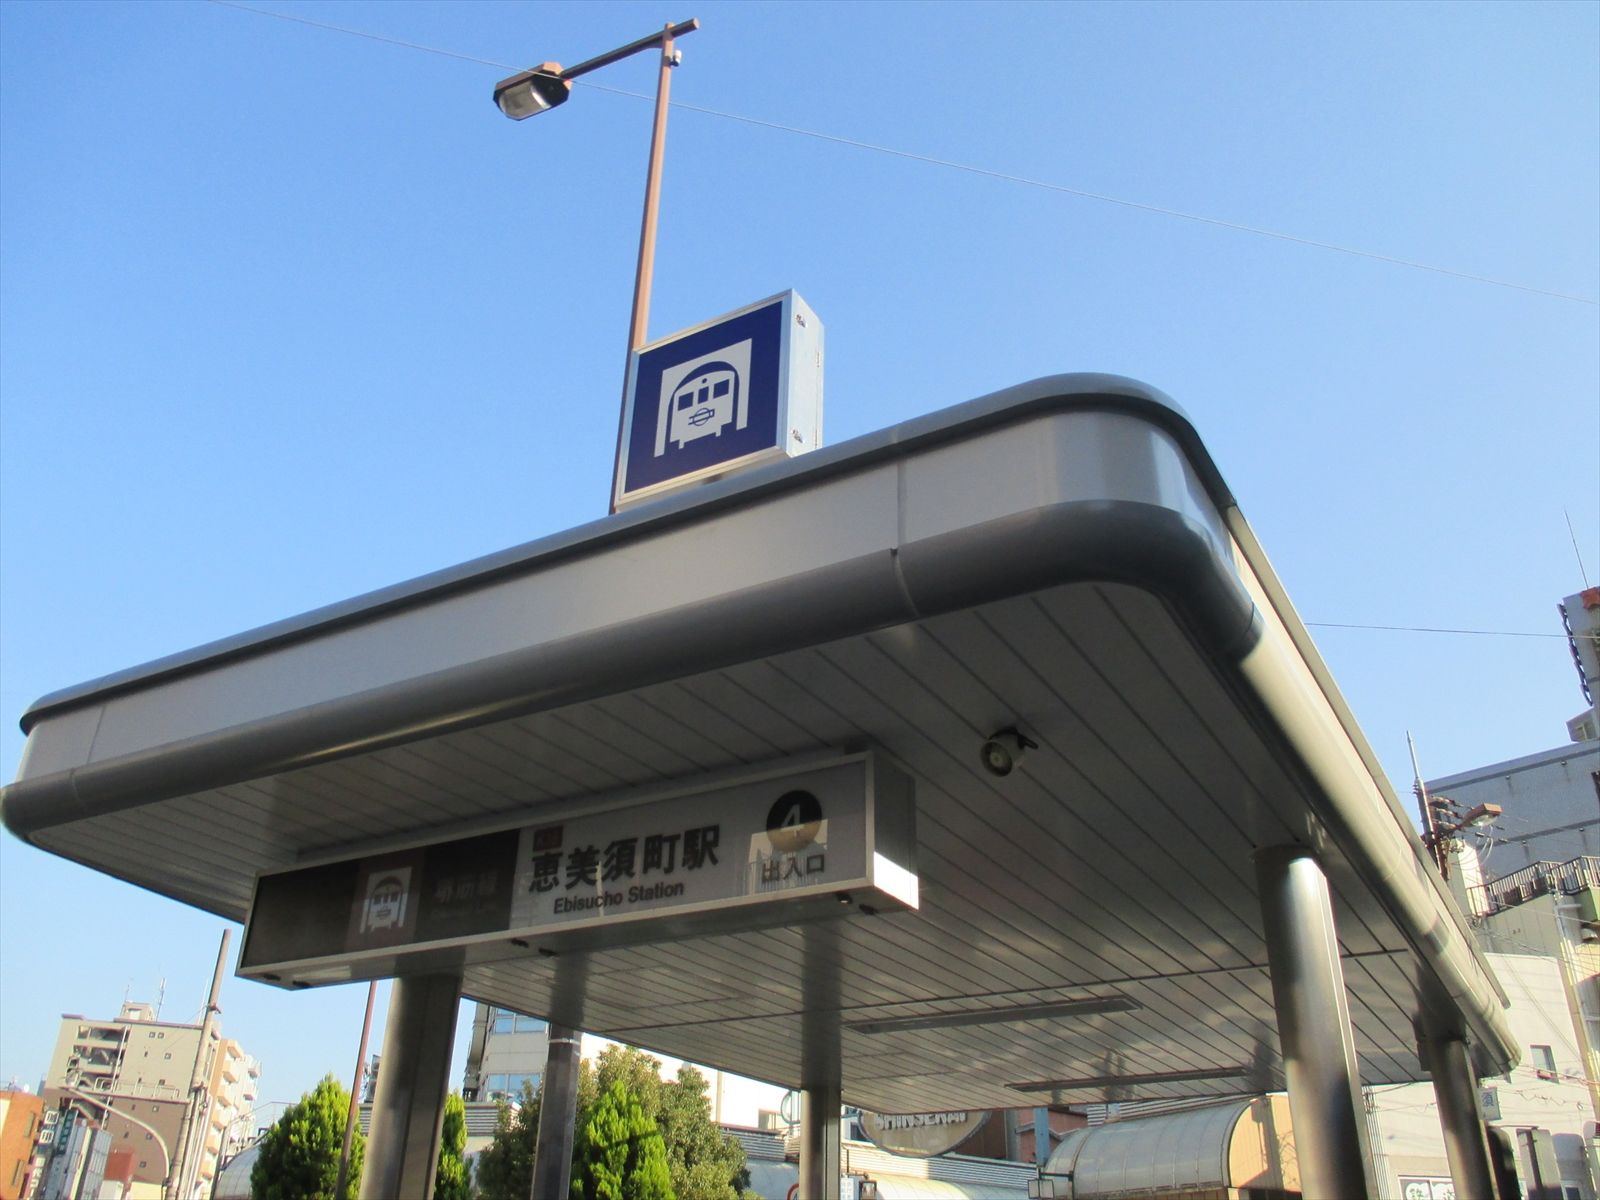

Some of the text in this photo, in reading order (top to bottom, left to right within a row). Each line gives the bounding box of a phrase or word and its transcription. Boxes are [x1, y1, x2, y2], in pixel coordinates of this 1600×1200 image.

[781, 803, 806, 838] 4
[528, 824, 720, 893] 恵美須町駅
[761, 853, 825, 884] 出入口
[553, 881, 685, 915] Ebisucho Station
